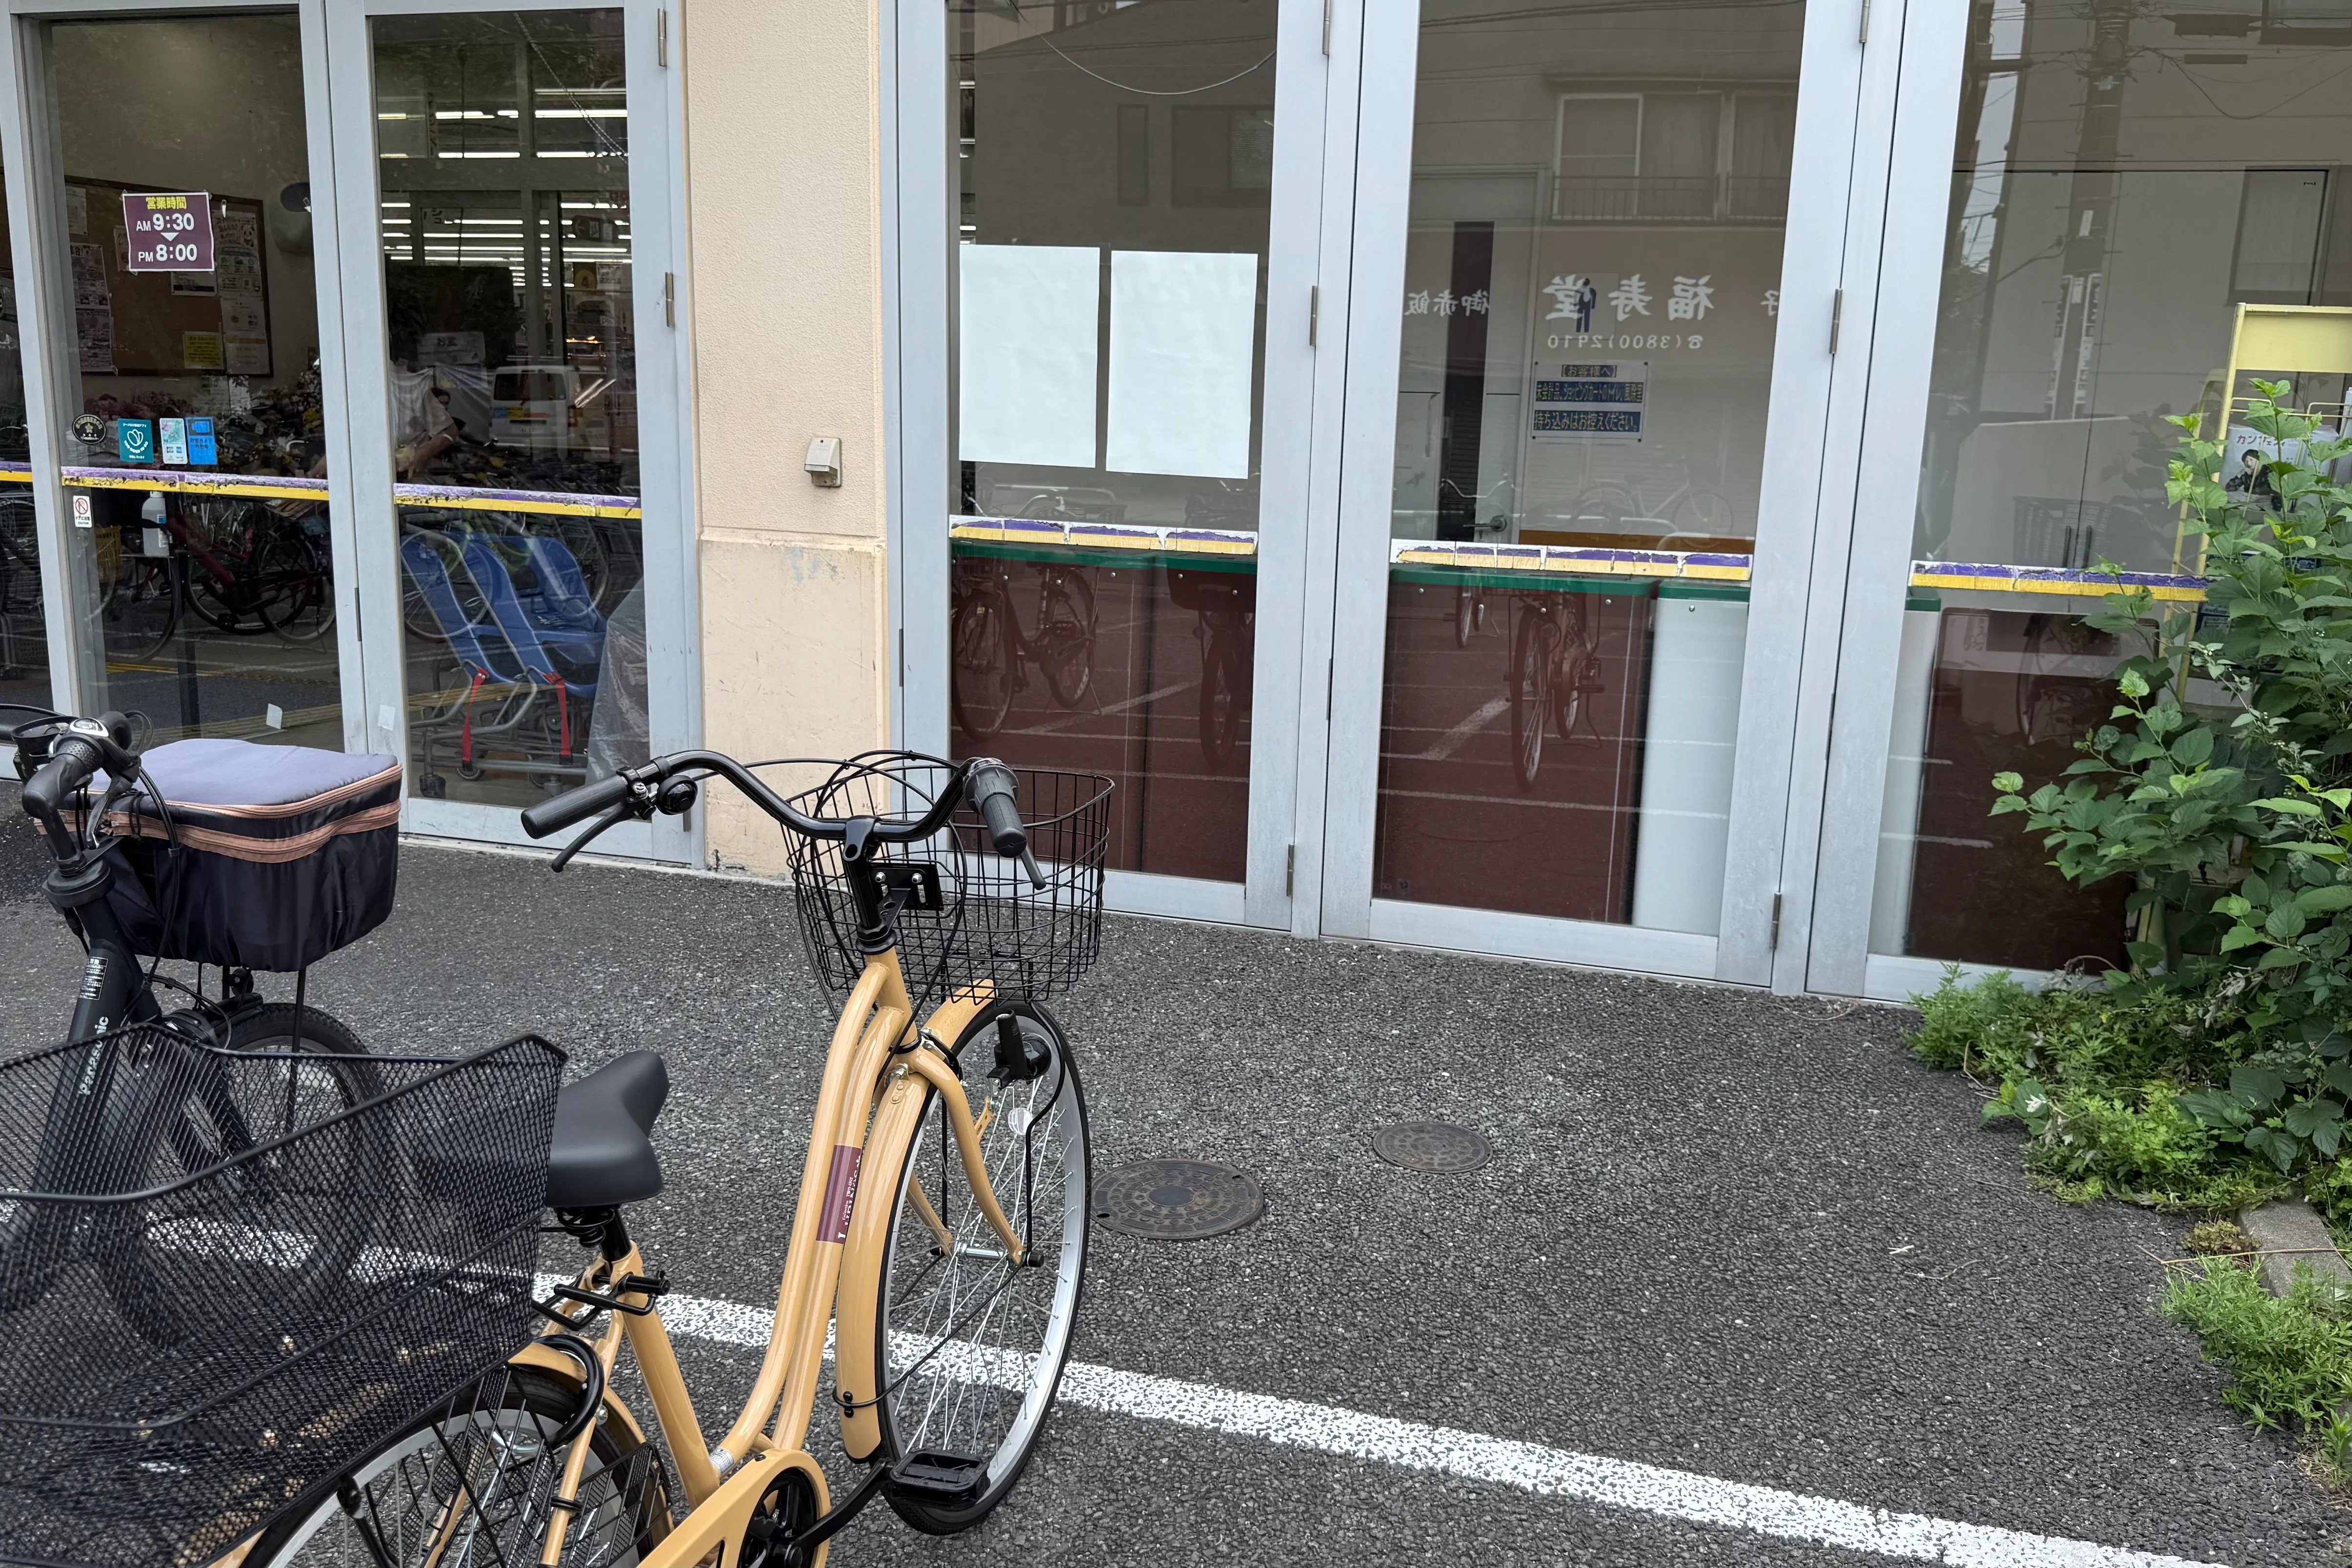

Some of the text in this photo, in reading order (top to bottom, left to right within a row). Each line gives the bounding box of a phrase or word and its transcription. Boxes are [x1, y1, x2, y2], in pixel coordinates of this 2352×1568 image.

[146, 196, 187, 209] 営業時間
[136, 213, 194, 231] AM 9:30
[138, 244, 197, 262] PM 8:00
